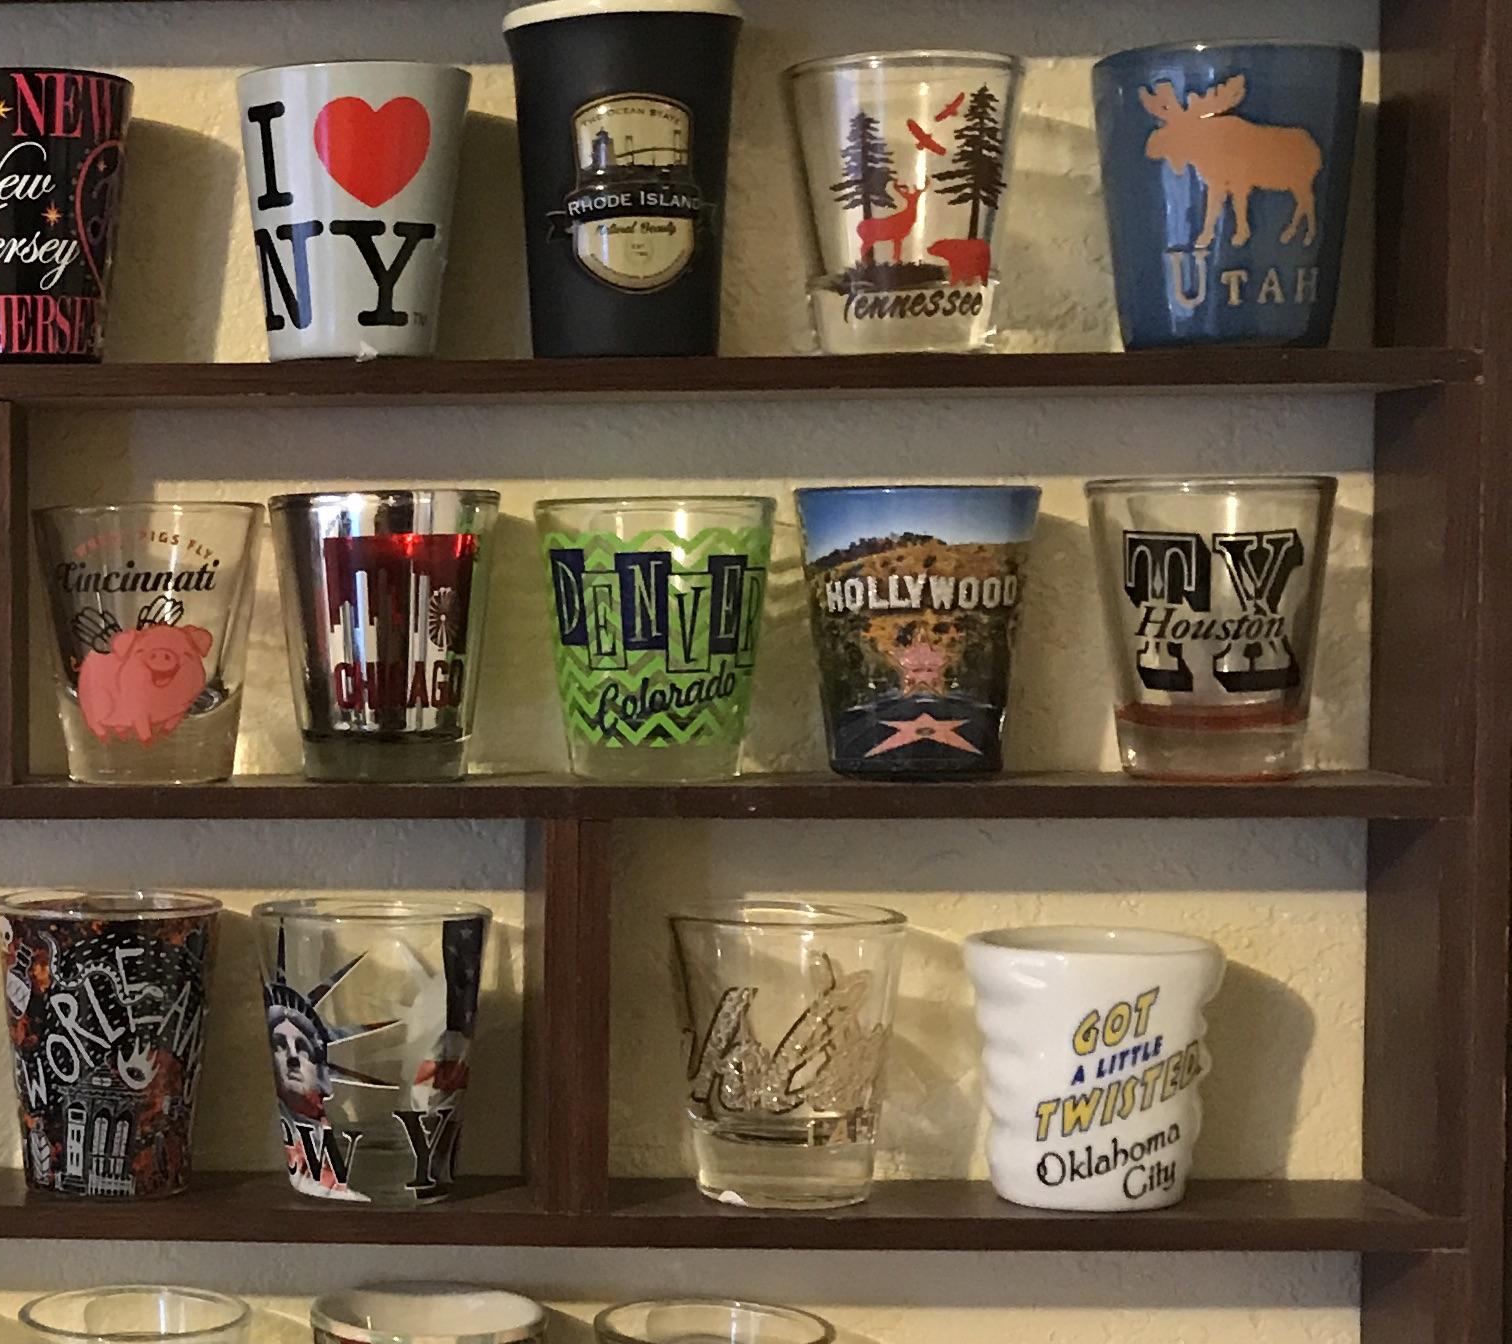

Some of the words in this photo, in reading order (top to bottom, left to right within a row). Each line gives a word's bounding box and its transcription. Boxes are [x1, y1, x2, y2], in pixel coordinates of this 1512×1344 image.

[11, 72, 115, 138] NEW
[608, 107, 646, 118] OCEAN
[649, 108, 681, 125] STATE
[247, 101, 293, 210] I
[568, 192, 633, 217] RHODE
[639, 190, 701, 211] ISLAND
[256, 219, 436, 332] NY
[1163, 250, 1320, 307] UTAH
[842, 288, 983, 324] Tennessee
[139, 528, 181, 548] PIGS
[187, 537, 215, 560] FLY
[55, 559, 220, 594] Cincinnati
[826, 574, 1018, 613] HOLLYWOOD
[1135, 604, 1285, 642] Houston
[333, 660, 465, 711] CHICAGO
[598, 659, 736, 737] Colorado
[1072, 986, 1160, 1056] GOT
[1071, 1064, 1085, 1086] A
[1096, 1035, 1164, 1077] LITTLE
[1035, 1040, 1202, 1143] TWISTED
[1036, 1123, 1181, 1187] Oklahoma
[1122, 1159, 1178, 1201] City
